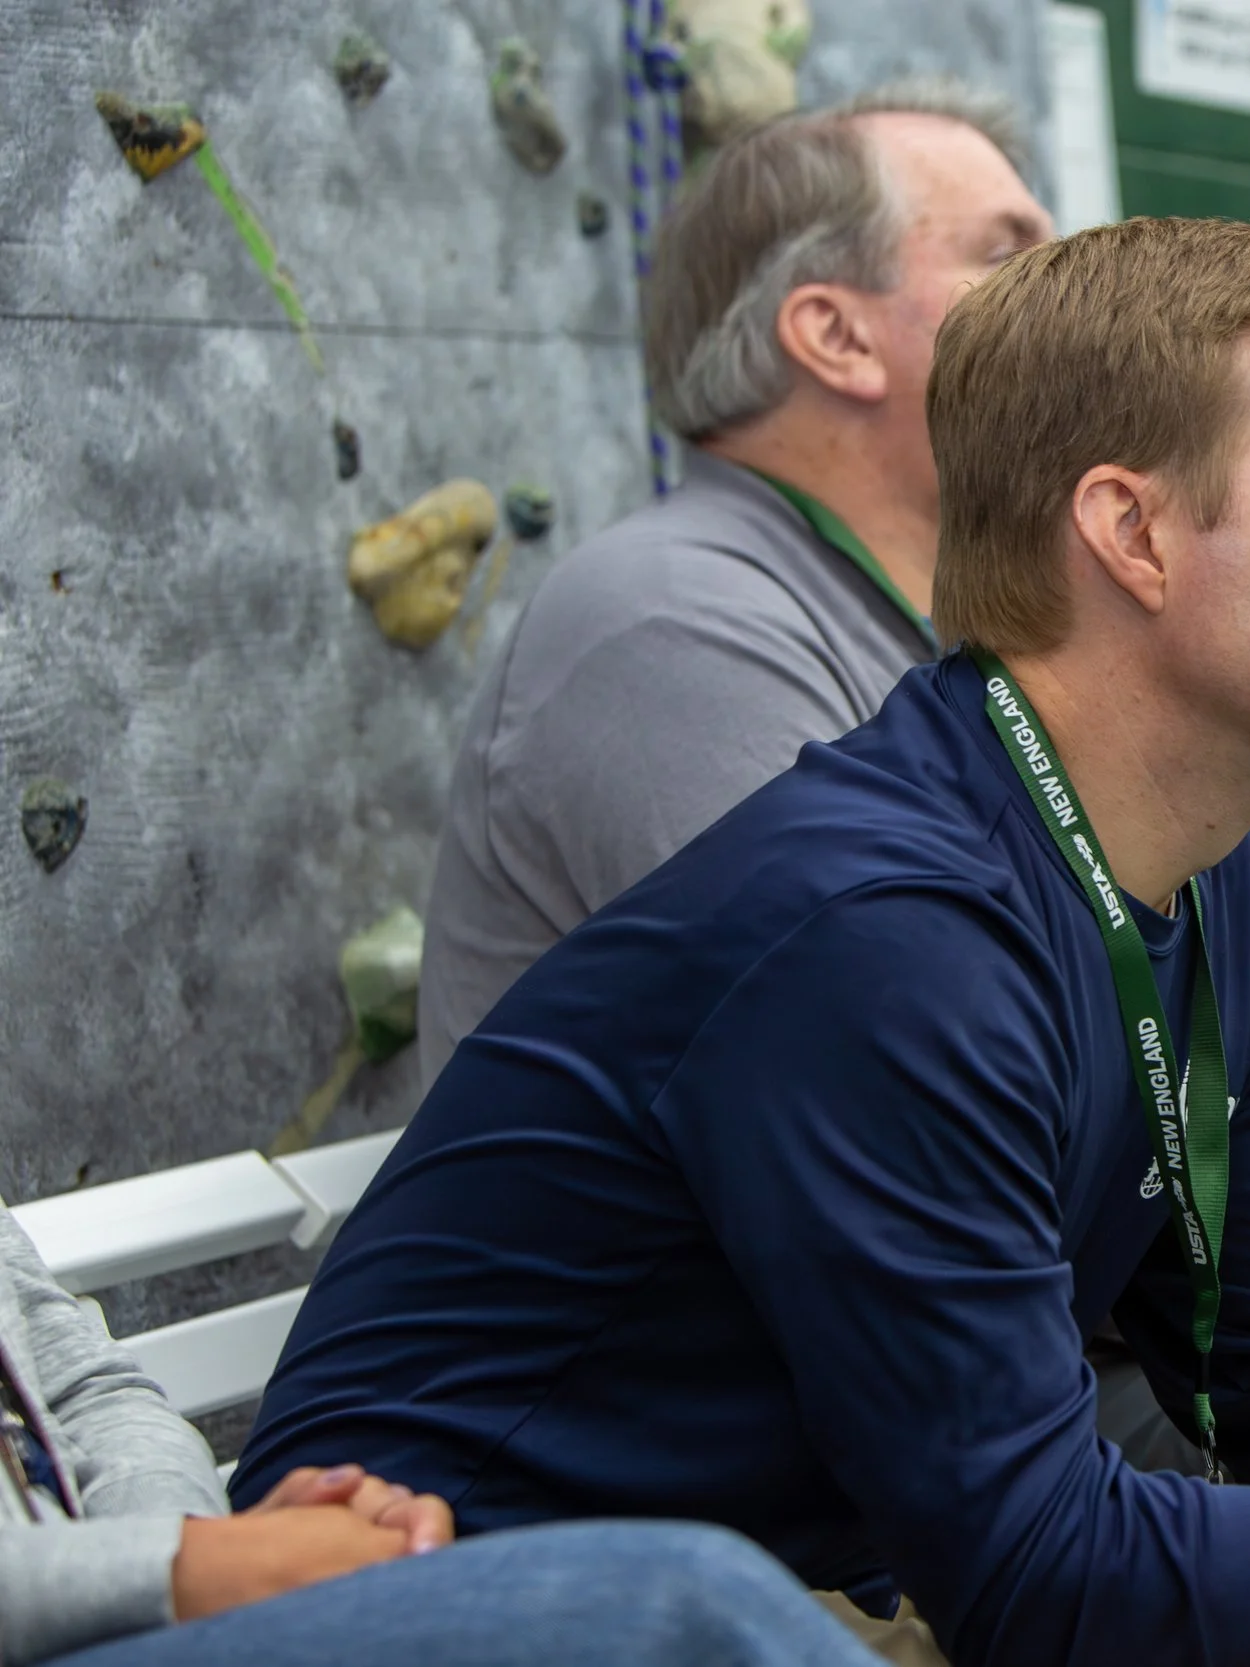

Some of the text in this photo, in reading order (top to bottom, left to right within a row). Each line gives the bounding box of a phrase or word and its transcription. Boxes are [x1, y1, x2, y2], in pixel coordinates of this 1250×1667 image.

[986, 676, 1126, 930] USTA NEW ENGLAND
[1138, 1017, 1208, 1265] USTA NEW ENGLAND
